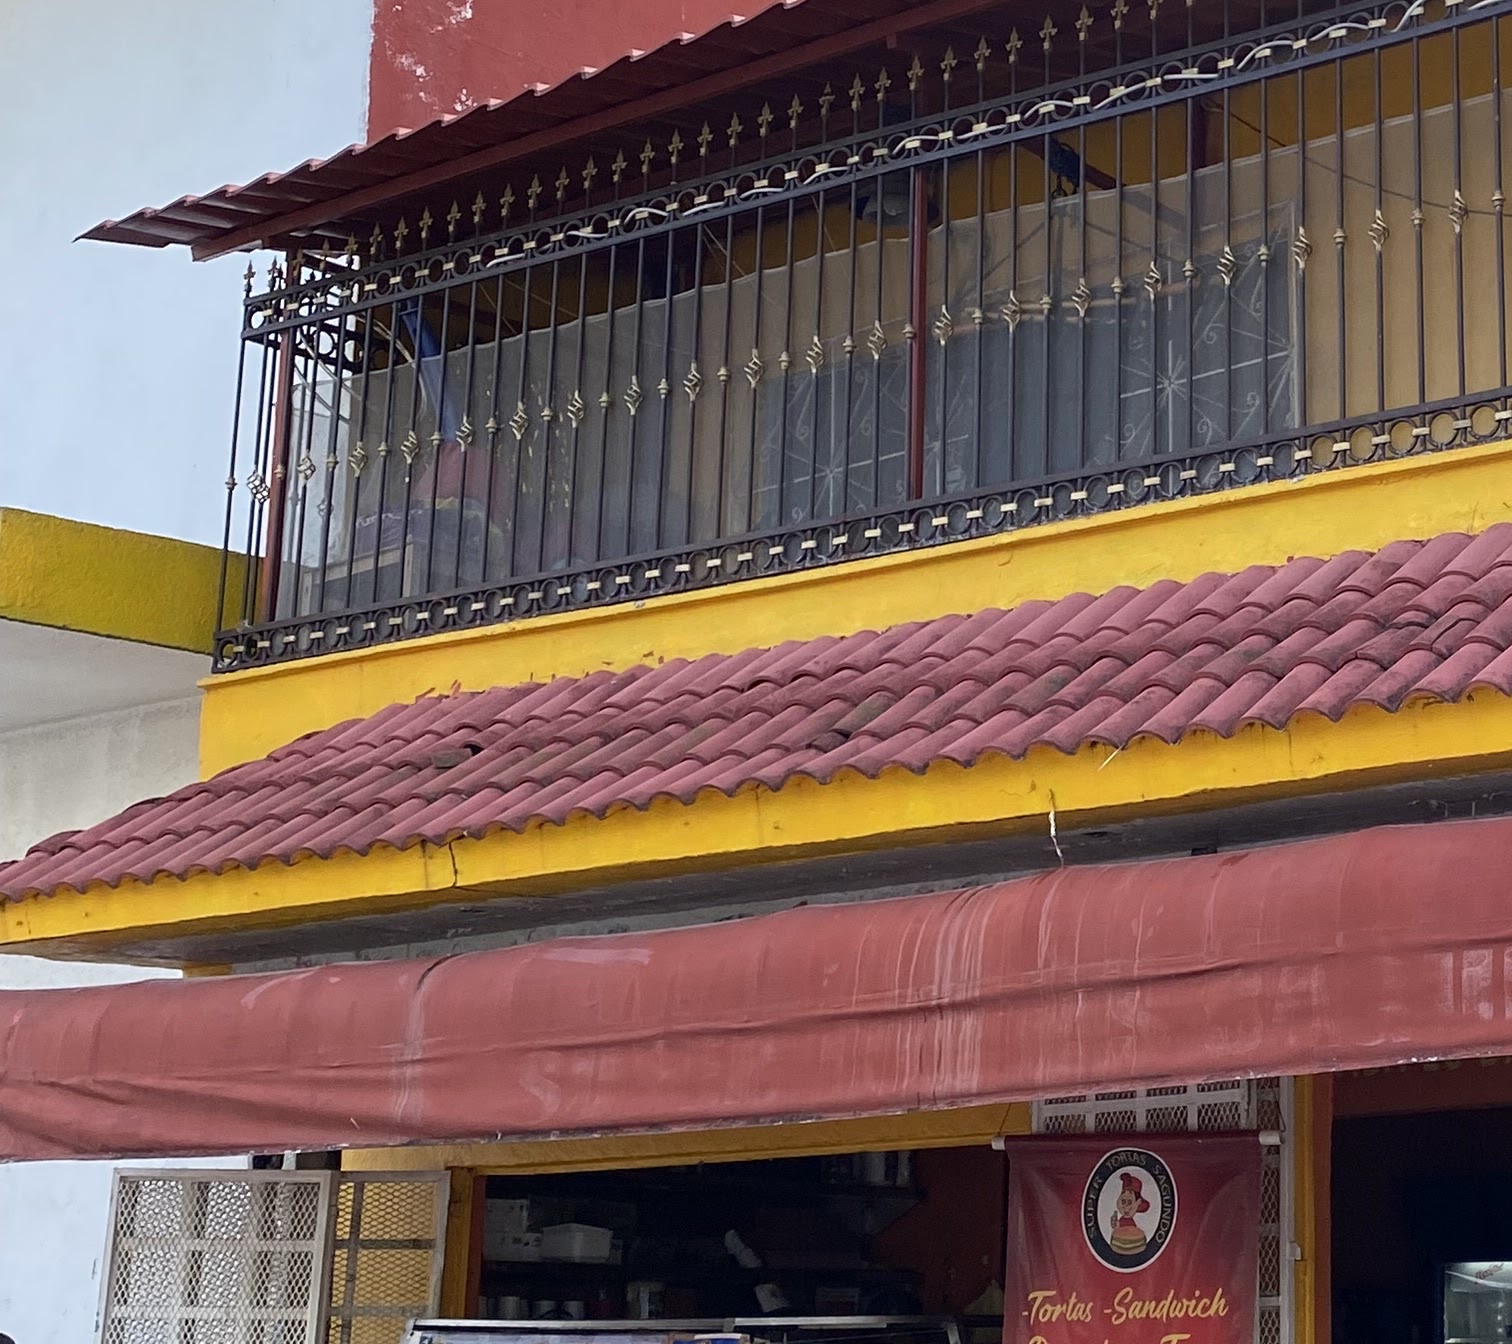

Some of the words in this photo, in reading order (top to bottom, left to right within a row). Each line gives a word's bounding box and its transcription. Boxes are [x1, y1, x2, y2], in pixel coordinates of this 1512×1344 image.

[1086, 1176, 1102, 1239] SUPER
[1105, 1151, 1147, 1171] TORTAS
[1153, 1164, 1171, 1243] SAGUNDO
